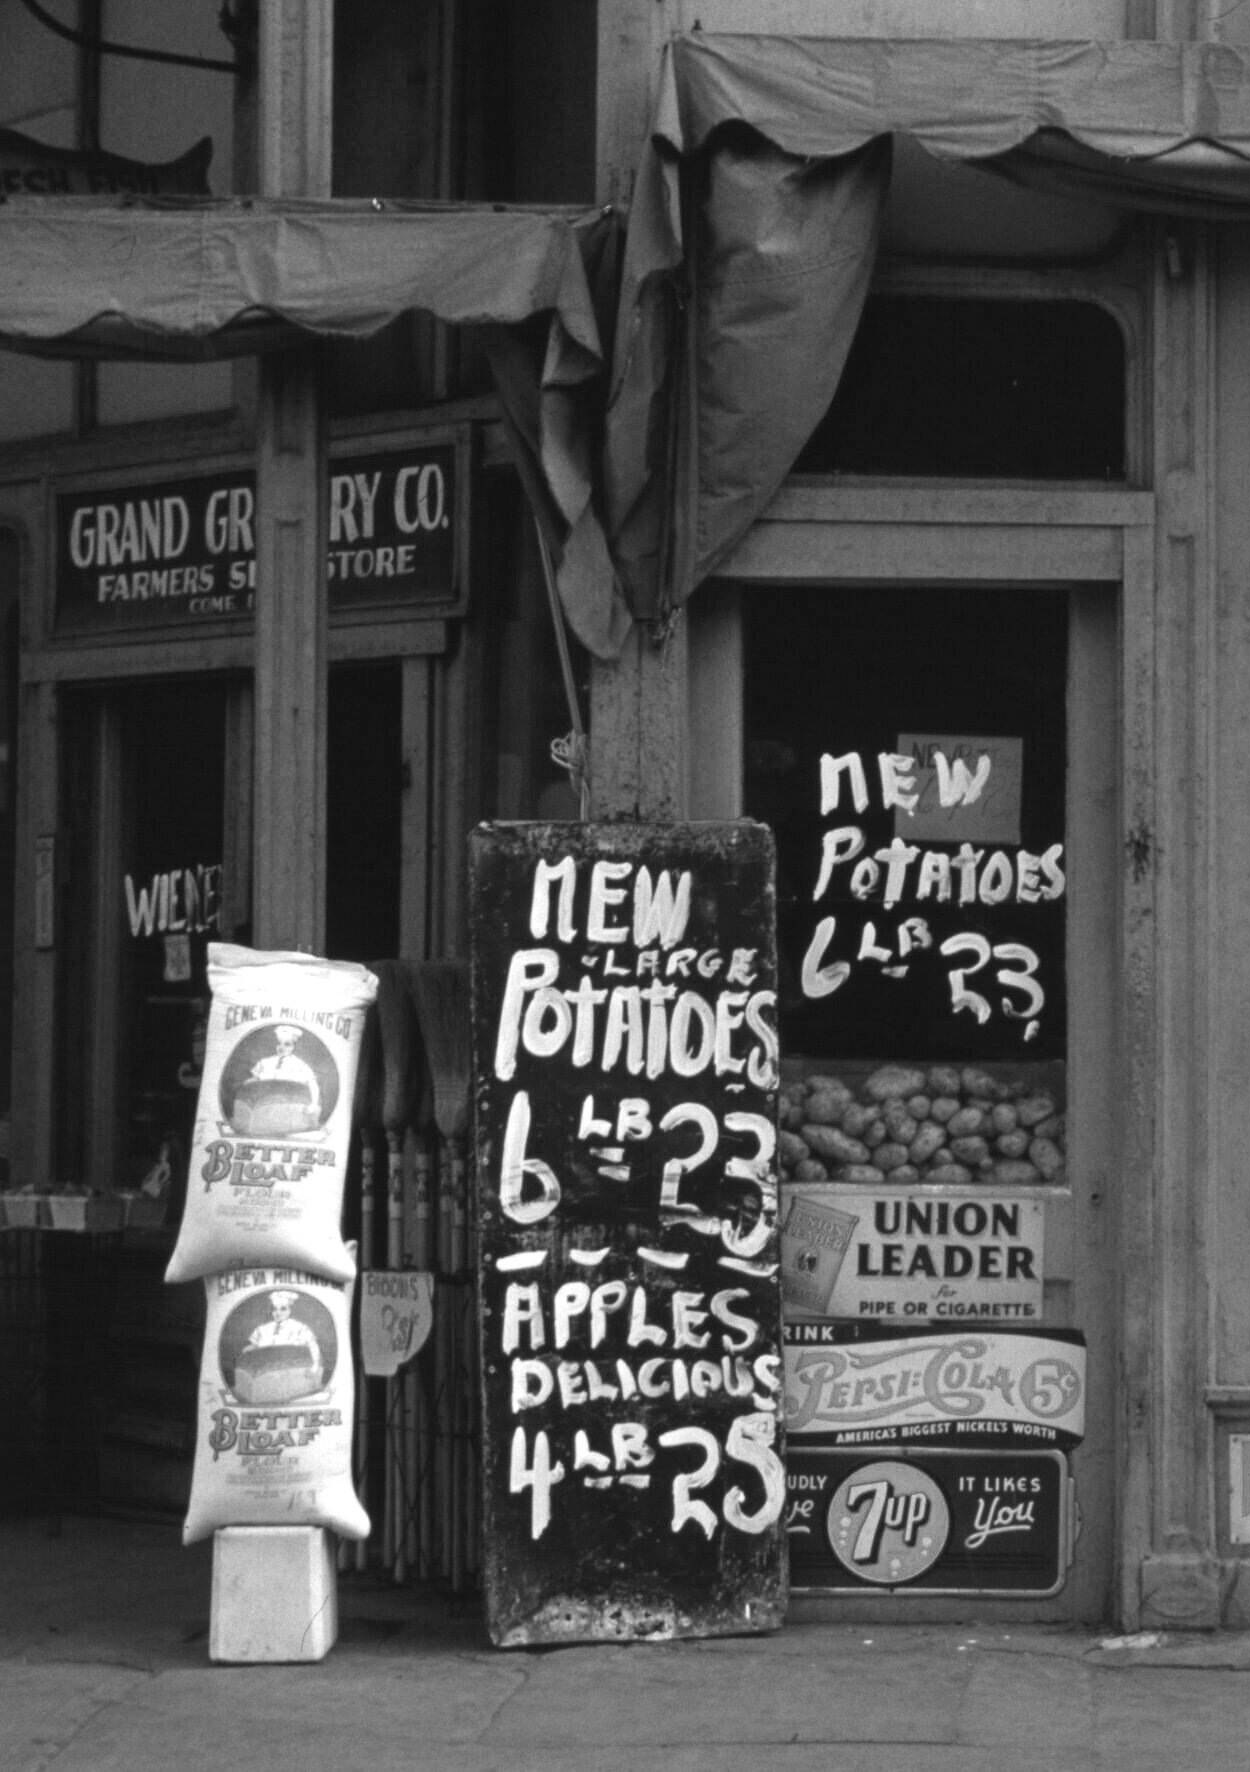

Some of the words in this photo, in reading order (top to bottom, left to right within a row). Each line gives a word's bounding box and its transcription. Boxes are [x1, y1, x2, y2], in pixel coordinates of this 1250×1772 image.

[69, 496, 190, 570] GRAND
[204, 471, 382, 555] GRRY
[393, 463, 449, 533] CO.
[97, 563, 215, 603] FARMERS
[820, 751, 991, 816] NEW
[124, 863, 221, 937] WIENE
[529, 855, 692, 951] NEW
[801, 916, 851, 998] 6
[226, 1005, 273, 1030] GENEVA
[201, 1139, 335, 1193] BETTER
[229, 1161, 313, 1187] LOAF
[500, 1090, 561, 1225] 6
[578, 1095, 652, 1141] LB
[873, 1201, 1019, 1237] UNION
[856, 1243, 1038, 1280] LEADER
[859, 1301, 896, 1316] PIPE
[903, 1302, 928, 1316] OR
[936, 1302, 1036, 1317] CIGARETTE
[932, 1285, 957, 1300] for
[502, 1280, 758, 1355] APPLES
[783, 1326, 833, 1340] RINK
[511, 1354, 780, 1413] DELICIOUS
[209, 1408, 342, 1462] BETTER
[237, 1429, 319, 1455] LOAF
[902, 1422, 950, 1437] BIGGEST
[1012, 1423, 1057, 1440] WORTH
[510, 1426, 565, 1540] 4
[574, 1422, 655, 1470] LB
[658, 1412, 786, 1540] 25
[787, 1474, 828, 1490] UDLY
[959, 1477, 975, 1492] IT
[984, 1477, 1041, 1493] LIKES
[965, 1497, 1034, 1549] You
